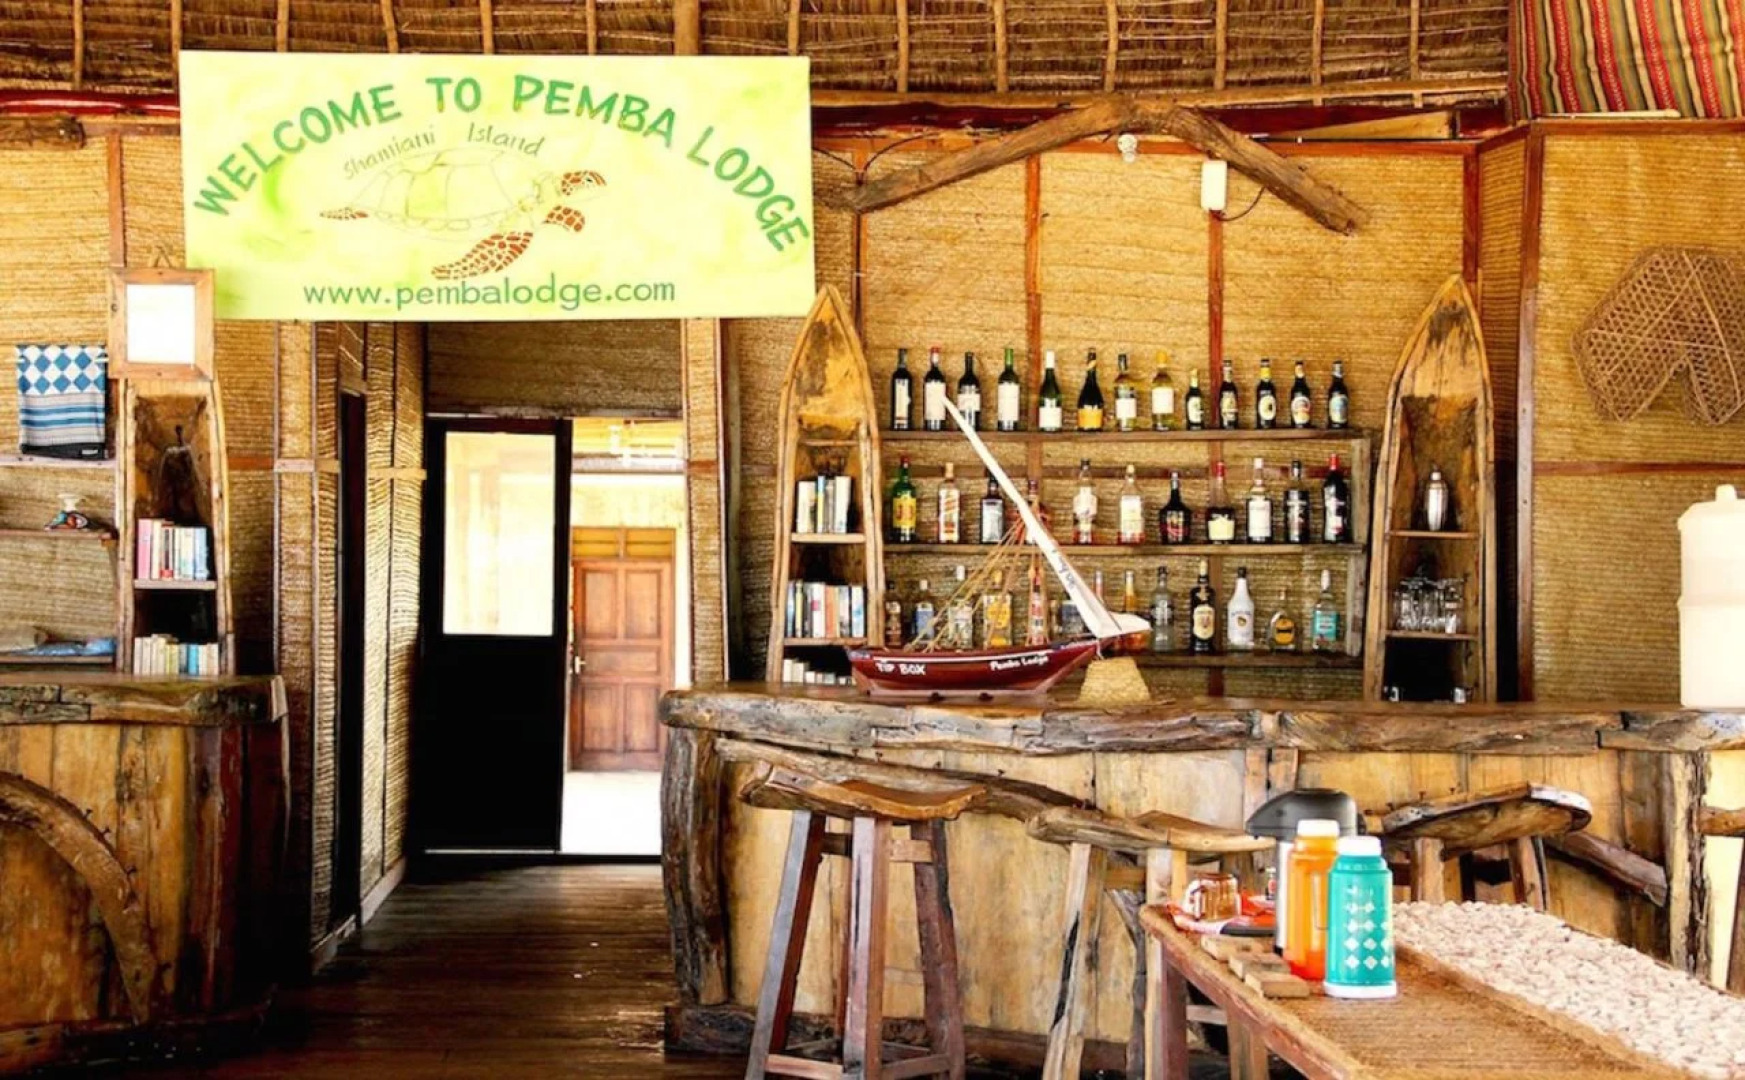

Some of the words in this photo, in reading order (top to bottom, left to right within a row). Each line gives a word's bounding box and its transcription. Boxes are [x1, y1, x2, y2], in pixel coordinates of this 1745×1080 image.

[467, 122, 545, 157] Island
[194, 84, 402, 217] WELCOME
[425, 76, 483, 113] TO
[512, 73, 677, 148] PEMBA
[687, 126, 810, 252] LODGE
[302, 273, 676, 310] www.pembalodge.com
[899, 663, 926, 676] BOX
